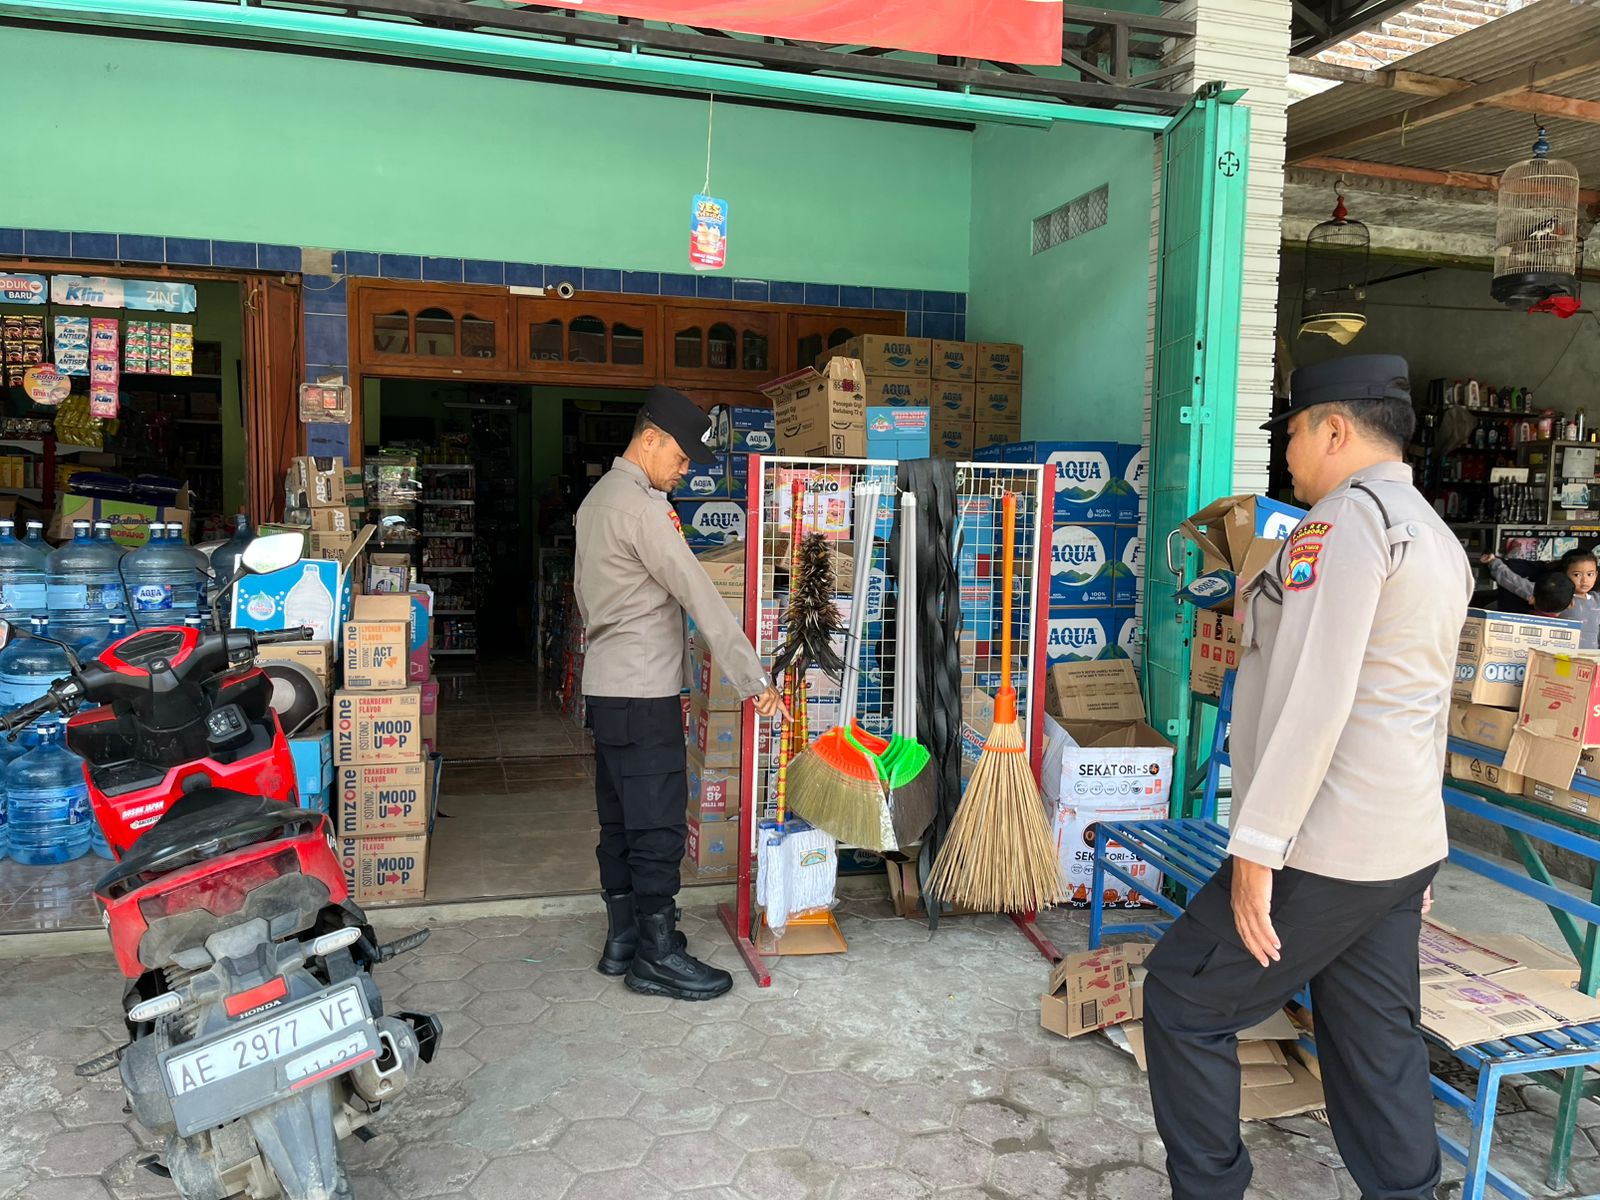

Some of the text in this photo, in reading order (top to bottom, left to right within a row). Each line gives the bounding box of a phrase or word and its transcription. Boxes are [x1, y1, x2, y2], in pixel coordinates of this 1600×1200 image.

[0, 280, 27, 289] ODUK
[65, 286, 104, 302] Klin
[146, 288, 181, 305] ZINC
[96, 332, 112, 340] Klin
[883, 342, 912, 356] AQUA
[944, 351, 964, 362] AQUA
[990, 354, 1010, 363] AQUA
[96, 364, 112, 372] Klin
[31, 373, 64, 382] Sedaap
[882, 384, 911, 397] AQUA
[942, 392, 962, 401] AQUA
[95, 395, 112, 403] Klin
[989, 394, 1009, 403] AQUA
[749, 435, 767, 443] AQUA
[942, 431, 962, 440] AQUA
[836, 437, 841, 450] 6
[1055, 461, 1102, 482] AQUA
[315, 476, 326, 503] ABC
[693, 480, 712, 488] AQUA
[699, 512, 740, 529] AQUA
[1051, 544, 1097, 565] AQUA
[140, 589, 162, 597] AQUA
[1194, 579, 1219, 594] AQUA
[868, 576, 881, 615] AQUA
[1048, 627, 1097, 648] AQUA
[348, 626, 357, 670] mizone
[373, 646, 392, 657] ACT
[359, 697, 393, 705] CRANBERRY
[339, 699, 352, 762] mizone
[374, 720, 412, 734] MOOD
[360, 721, 369, 750] ISOTONIC
[963, 729, 986, 748] Good
[364, 767, 398, 775] CRANBERRY
[344, 769, 356, 832] mizone
[379, 790, 416, 804] MOOD
[707, 792, 722, 801] 48
[364, 791, 374, 820] ISOTONIC
[377, 857, 414, 871] MOOD
[363, 858, 372, 887] ISOTONIC
[239, 1000, 283, 1020] HONDA
[179, 997, 353, 1093] AE 2977 VF
